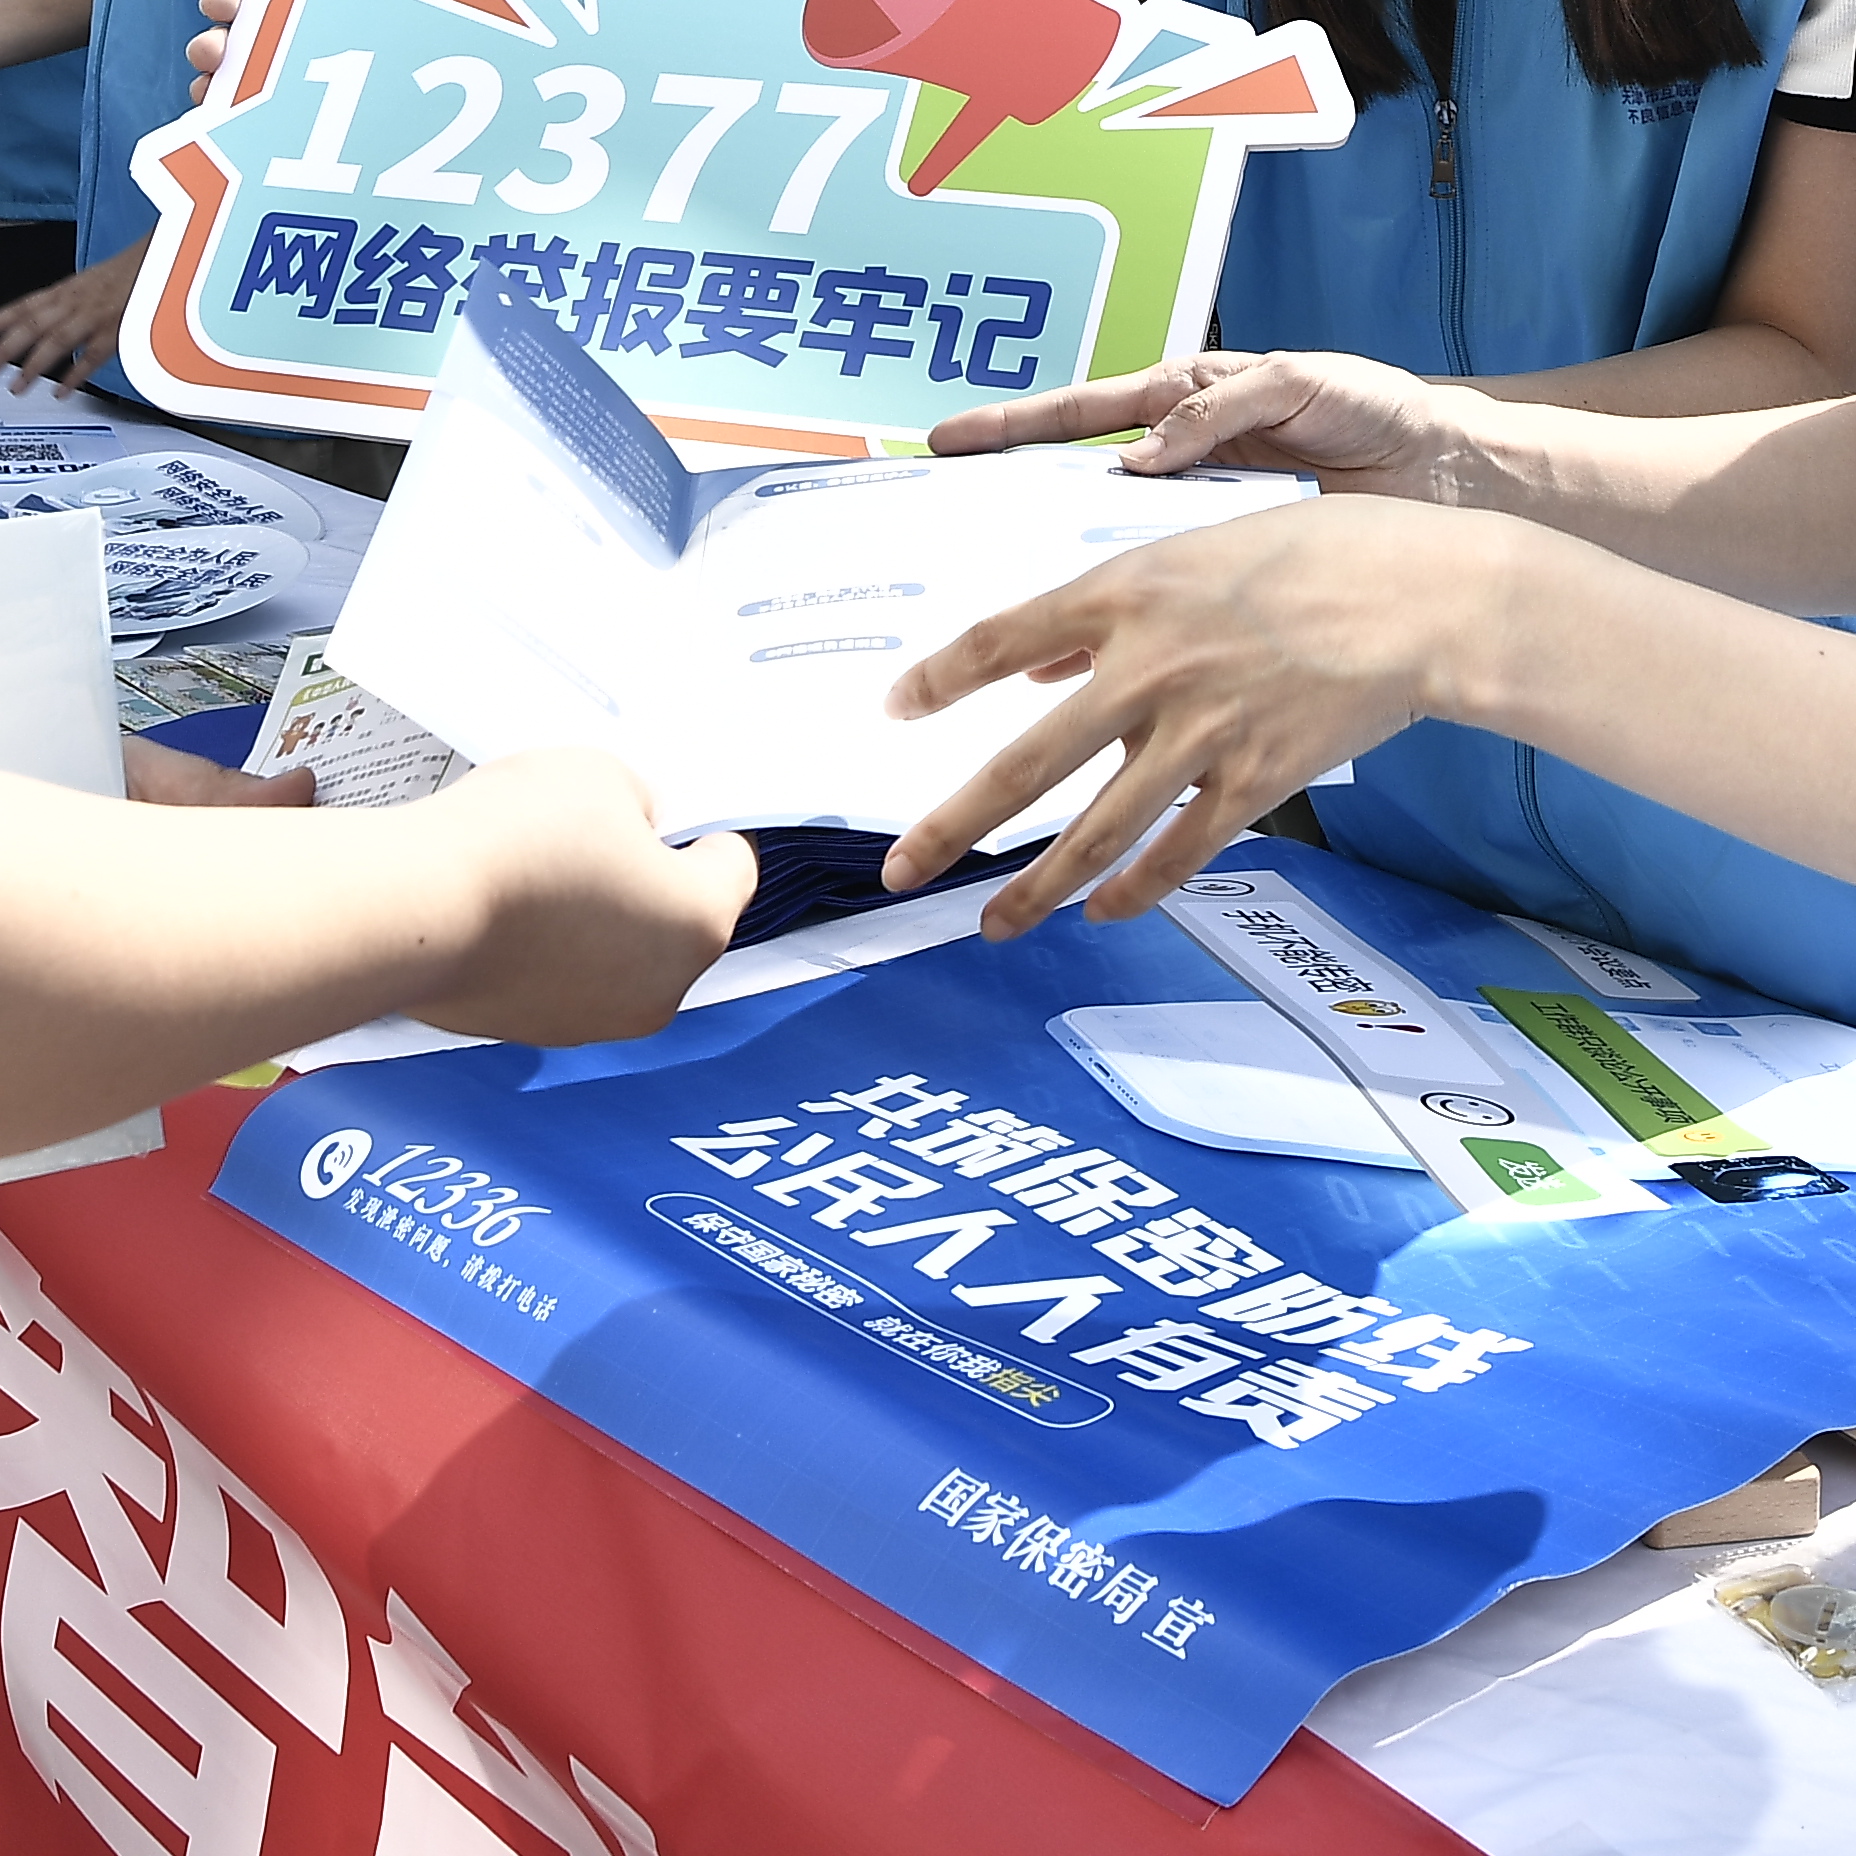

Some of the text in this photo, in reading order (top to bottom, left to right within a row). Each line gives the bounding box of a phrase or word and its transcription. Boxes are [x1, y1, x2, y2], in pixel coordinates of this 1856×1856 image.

[261, 47, 889, 236] 12377
[231, 210, 1054, 391] 网络举报要牢记
[1222, 909, 1375, 994] 手机不能传密
[363, 1143, 552, 1247] 12336
[669, 1115, 1398, 1451] 公民人人有责
[796, 1072, 1535, 1394] 共筑保密防线
[681, 1210, 1062, 1408] 保守国家秘密 就在你我指尖
[917, 1467, 1216, 1660] 国家保密局 宣
